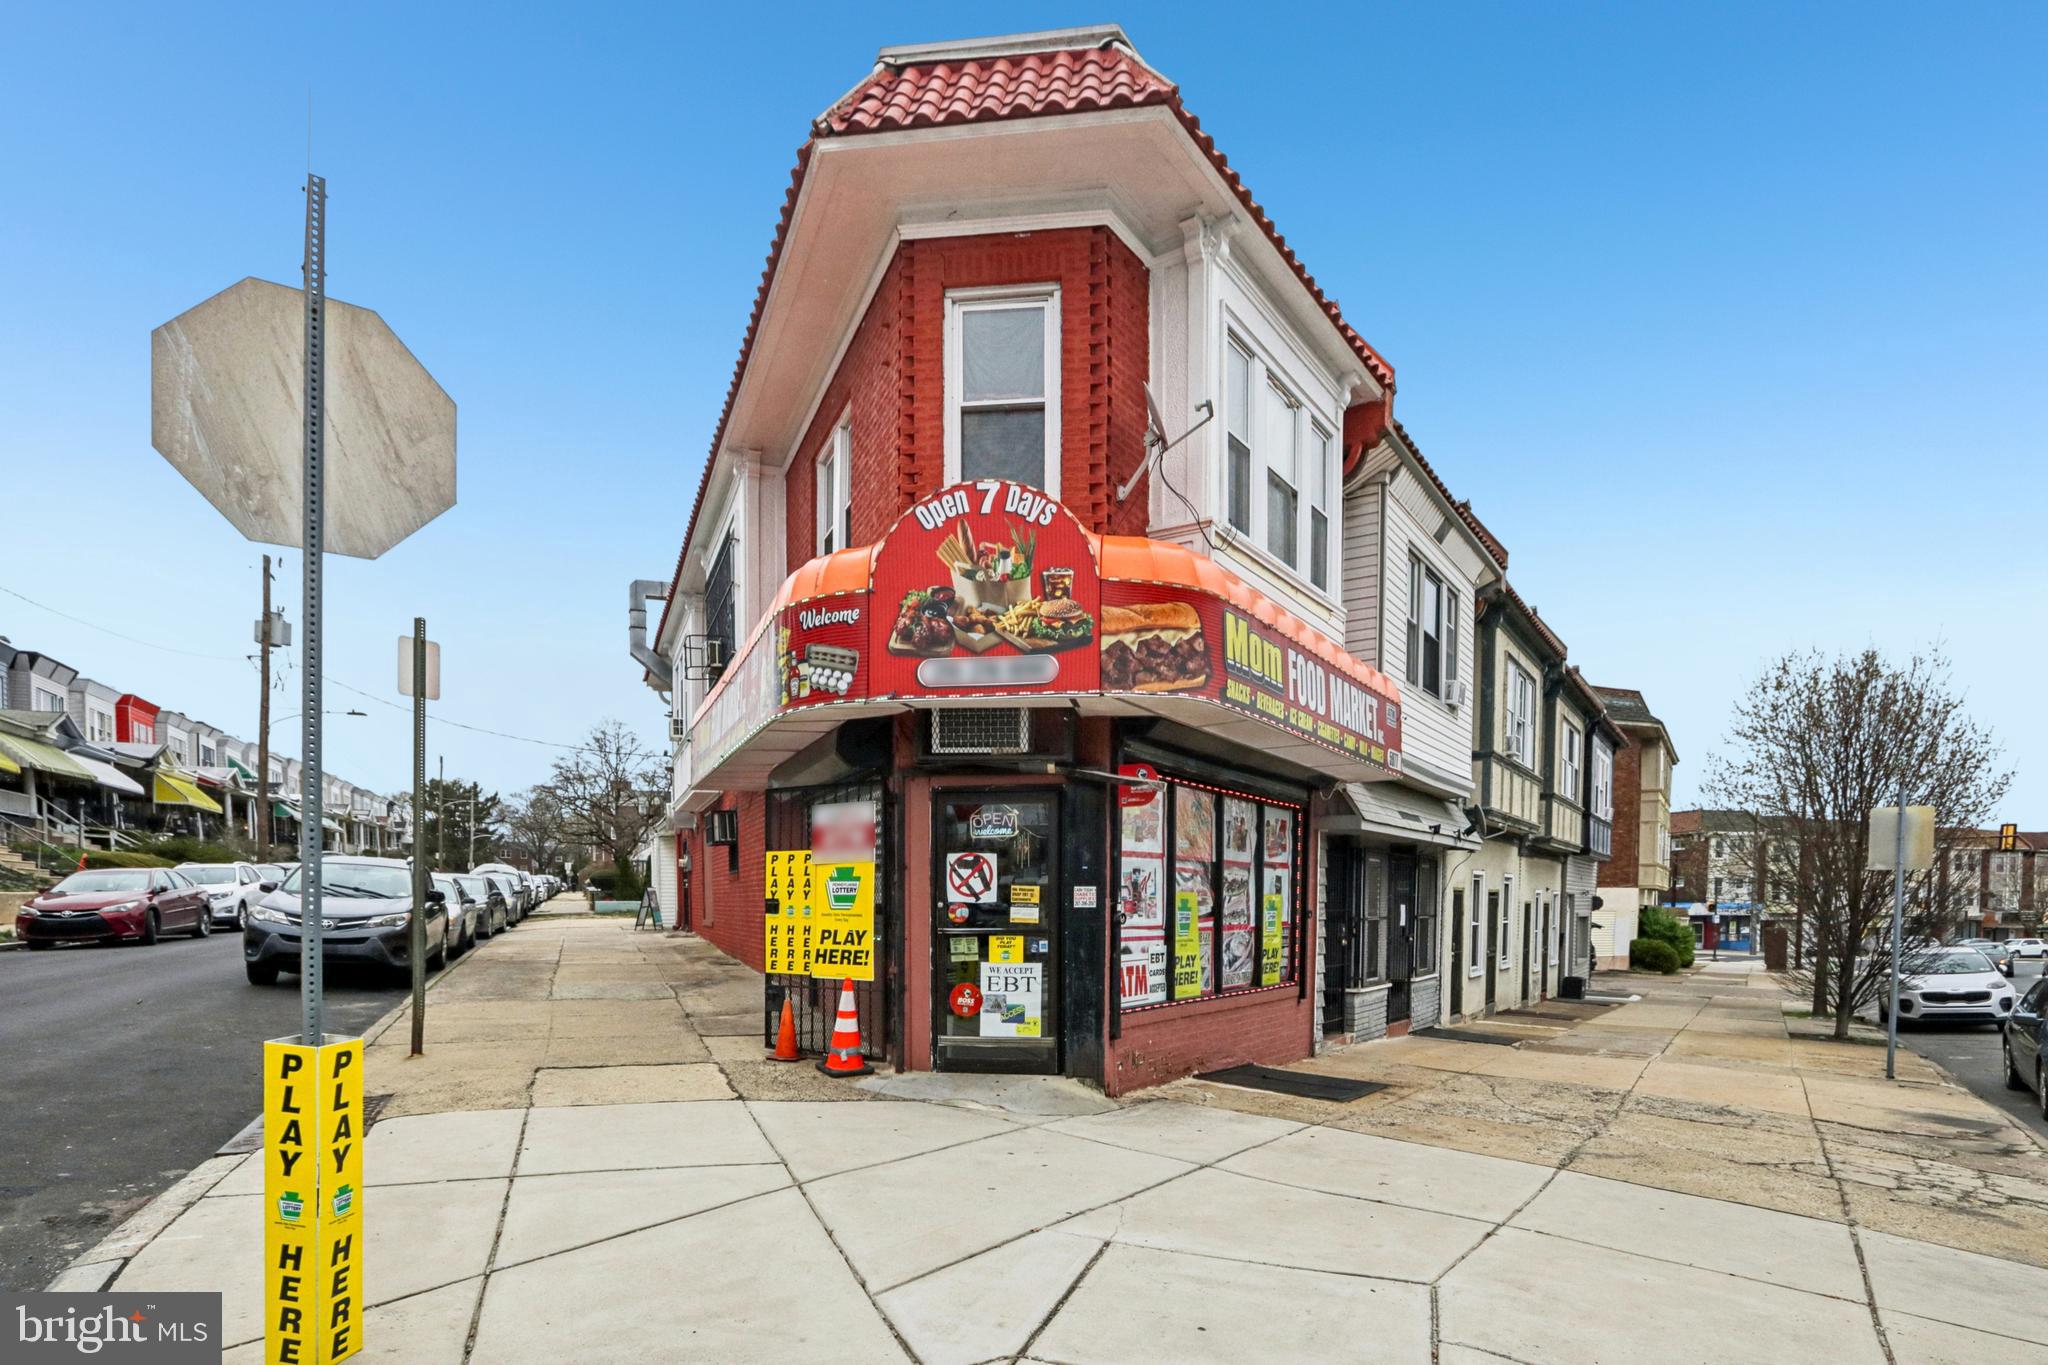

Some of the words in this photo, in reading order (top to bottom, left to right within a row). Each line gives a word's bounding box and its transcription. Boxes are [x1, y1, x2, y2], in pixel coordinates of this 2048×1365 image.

[914, 489, 970, 530] Open
[976, 482, 1000, 514] 7
[1005, 485, 1057, 525] Days
[799, 606, 860, 631] Welcome
[1225, 610, 1284, 686] Mom
[1226, 679, 1251, 704] SNACKS
[1287, 648, 1326, 716] FOOD
[1329, 673, 1378, 741] MARKET
[973, 812, 1014, 828] OPEN
[974, 825, 1013, 836] welcome
[770, 854, 778, 899] PLAY
[787, 854, 795, 900] PLAY
[803, 854, 811, 900] PLAY
[770, 925, 778, 970] HERE
[787, 925, 795, 971] HERE
[803, 925, 811, 972] HERE
[815, 948, 870, 966] HERE!
[819, 929, 867, 946] PLAY
[1150, 952, 1165, 964] EBT
[1003, 967, 1034, 975] ACCEPT
[1120, 965, 1148, 998] ATM
[1175, 954, 1197, 969] PLAY
[987, 976, 1037, 993] EBT
[279, 1054, 303, 1177] PLAY
[332, 1050, 352, 1174] PLAY
[278, 1244, 303, 1365] HERE
[330, 1234, 352, 1360] HERE
